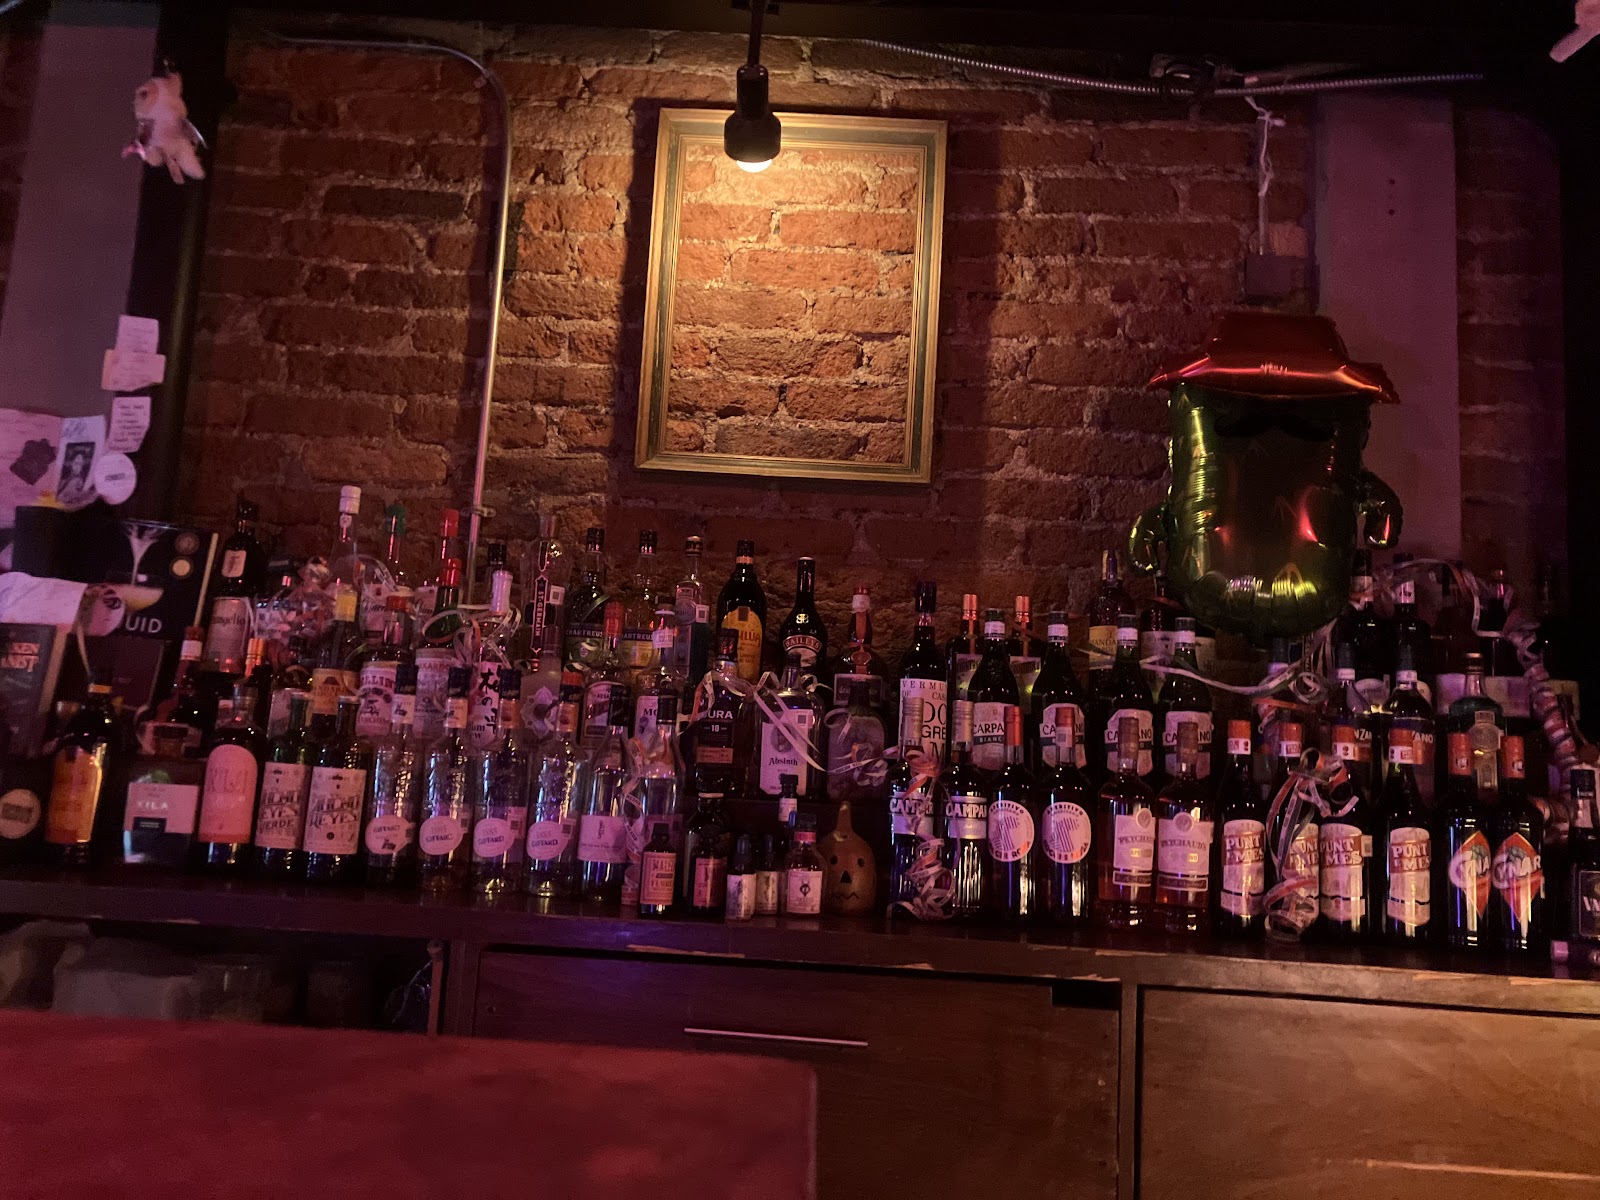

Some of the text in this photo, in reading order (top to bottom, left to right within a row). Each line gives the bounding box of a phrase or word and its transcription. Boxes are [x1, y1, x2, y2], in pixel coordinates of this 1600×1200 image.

[535, 590, 544, 637] ST-GERMAIN
[125, 615, 163, 633] UID
[622, 632, 653, 640] ARTREUS
[785, 635, 819, 650] BAILEYS
[902, 680, 947, 691] VERMU
[707, 709, 734, 720] URA
[711, 725, 720, 733] 10
[973, 723, 1005, 735] CARPA
[1107, 729, 1152, 741] CANO
[1165, 731, 1212, 743] CANO
[1412, 731, 1434, 744] ANO
[768, 757, 798, 766] Absinth
[477, 835, 505, 844] GIFFARD
[531, 838, 559, 847] GIFFARD
[1225, 835, 1260, 850] PUNT
[1321, 838, 1354, 852] PUNT
[1392, 842, 1428, 858] PUNT
[1325, 850, 1363, 865] MES
